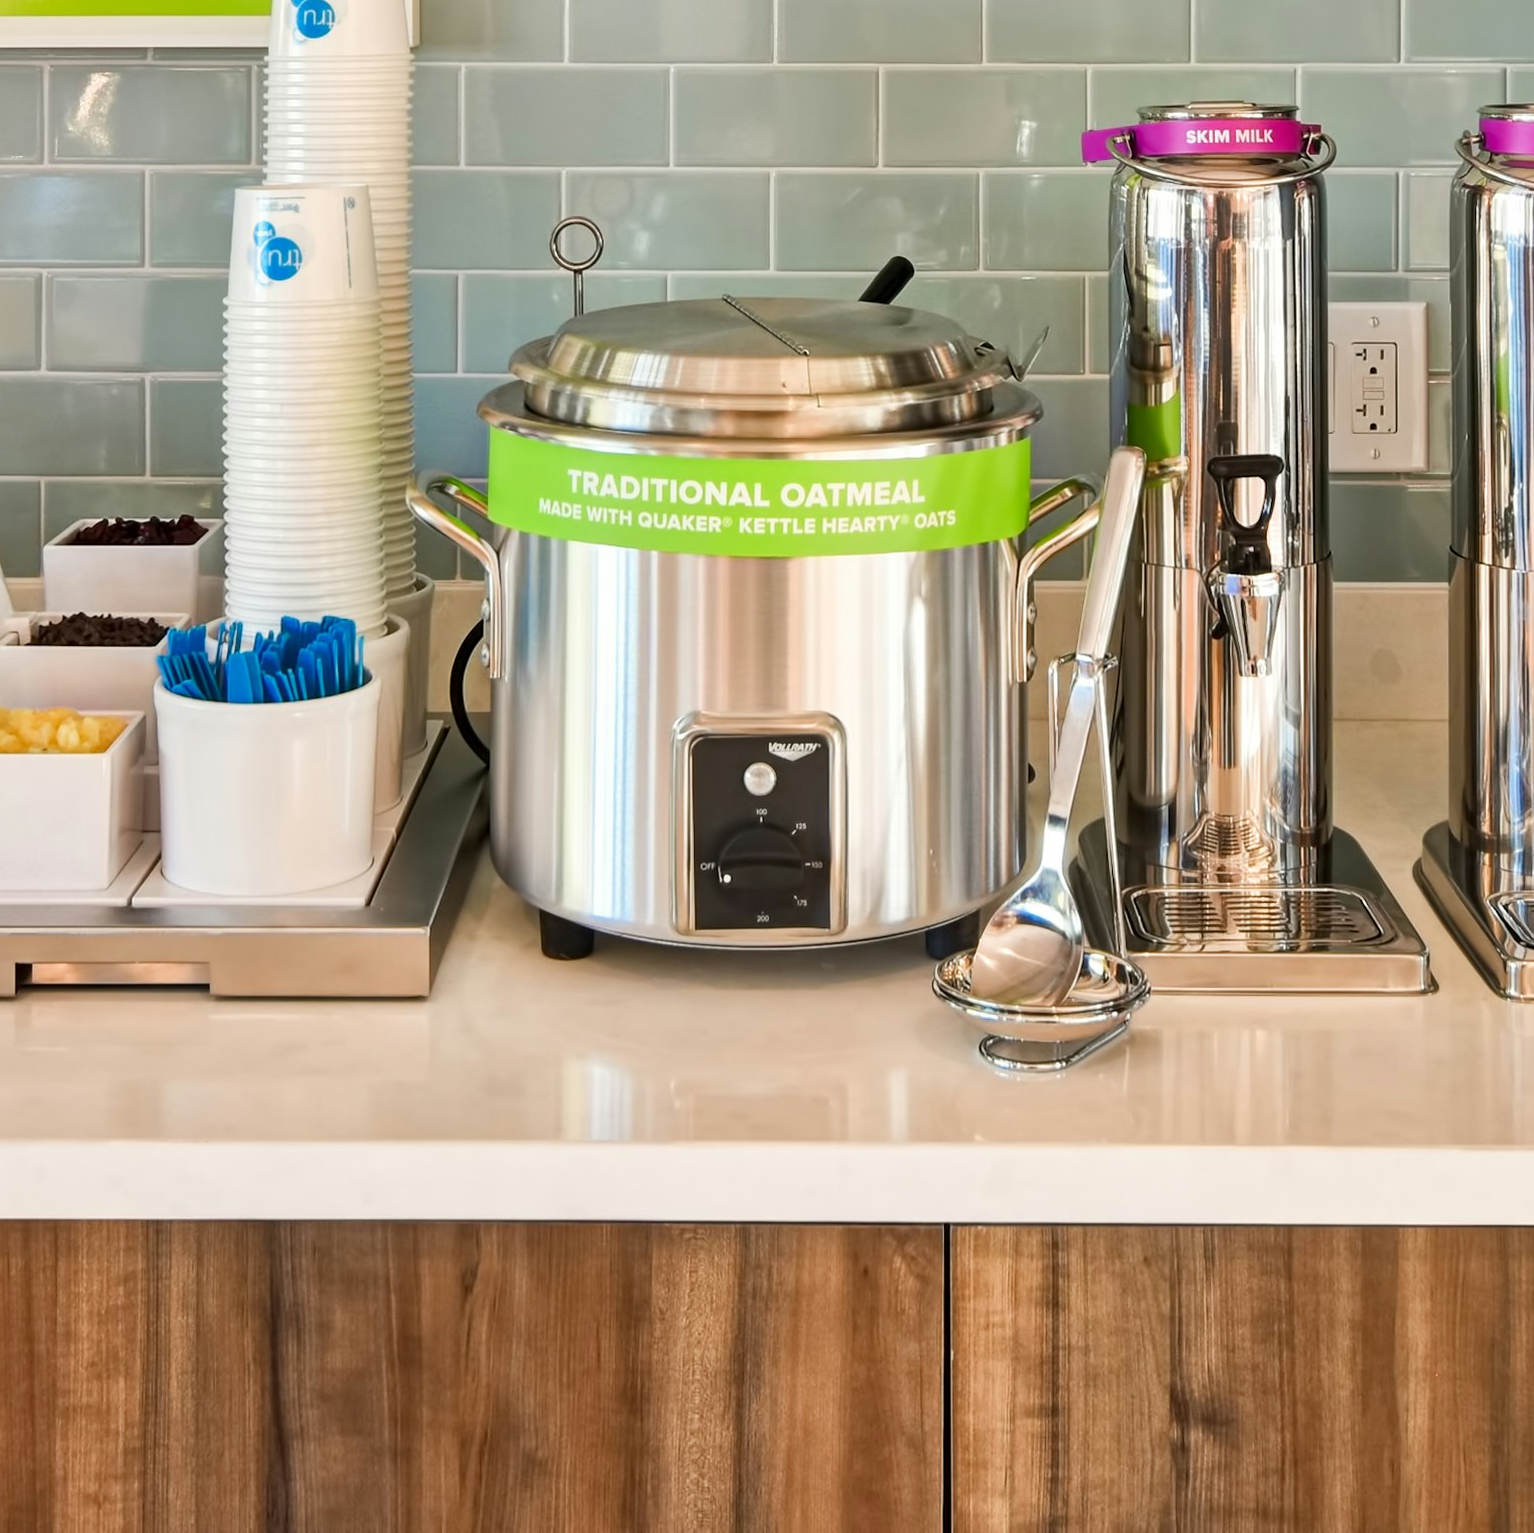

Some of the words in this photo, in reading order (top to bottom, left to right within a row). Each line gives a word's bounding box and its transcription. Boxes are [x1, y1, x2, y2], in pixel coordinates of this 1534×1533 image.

[1186, 129, 1230, 143] SKIM
[1235, 129, 1273, 143] MILK
[567, 468, 770, 508] TRADITIONAL
[780, 479, 925, 508] OATMEAL
[538, 498, 582, 520] MADE
[586, 505, 632, 527] WITH
[739, 517, 816, 534] KETTLE
[914, 510, 956, 529] OATS
[756, 808, 768, 816] 100
[756, 915, 769, 923] 200
